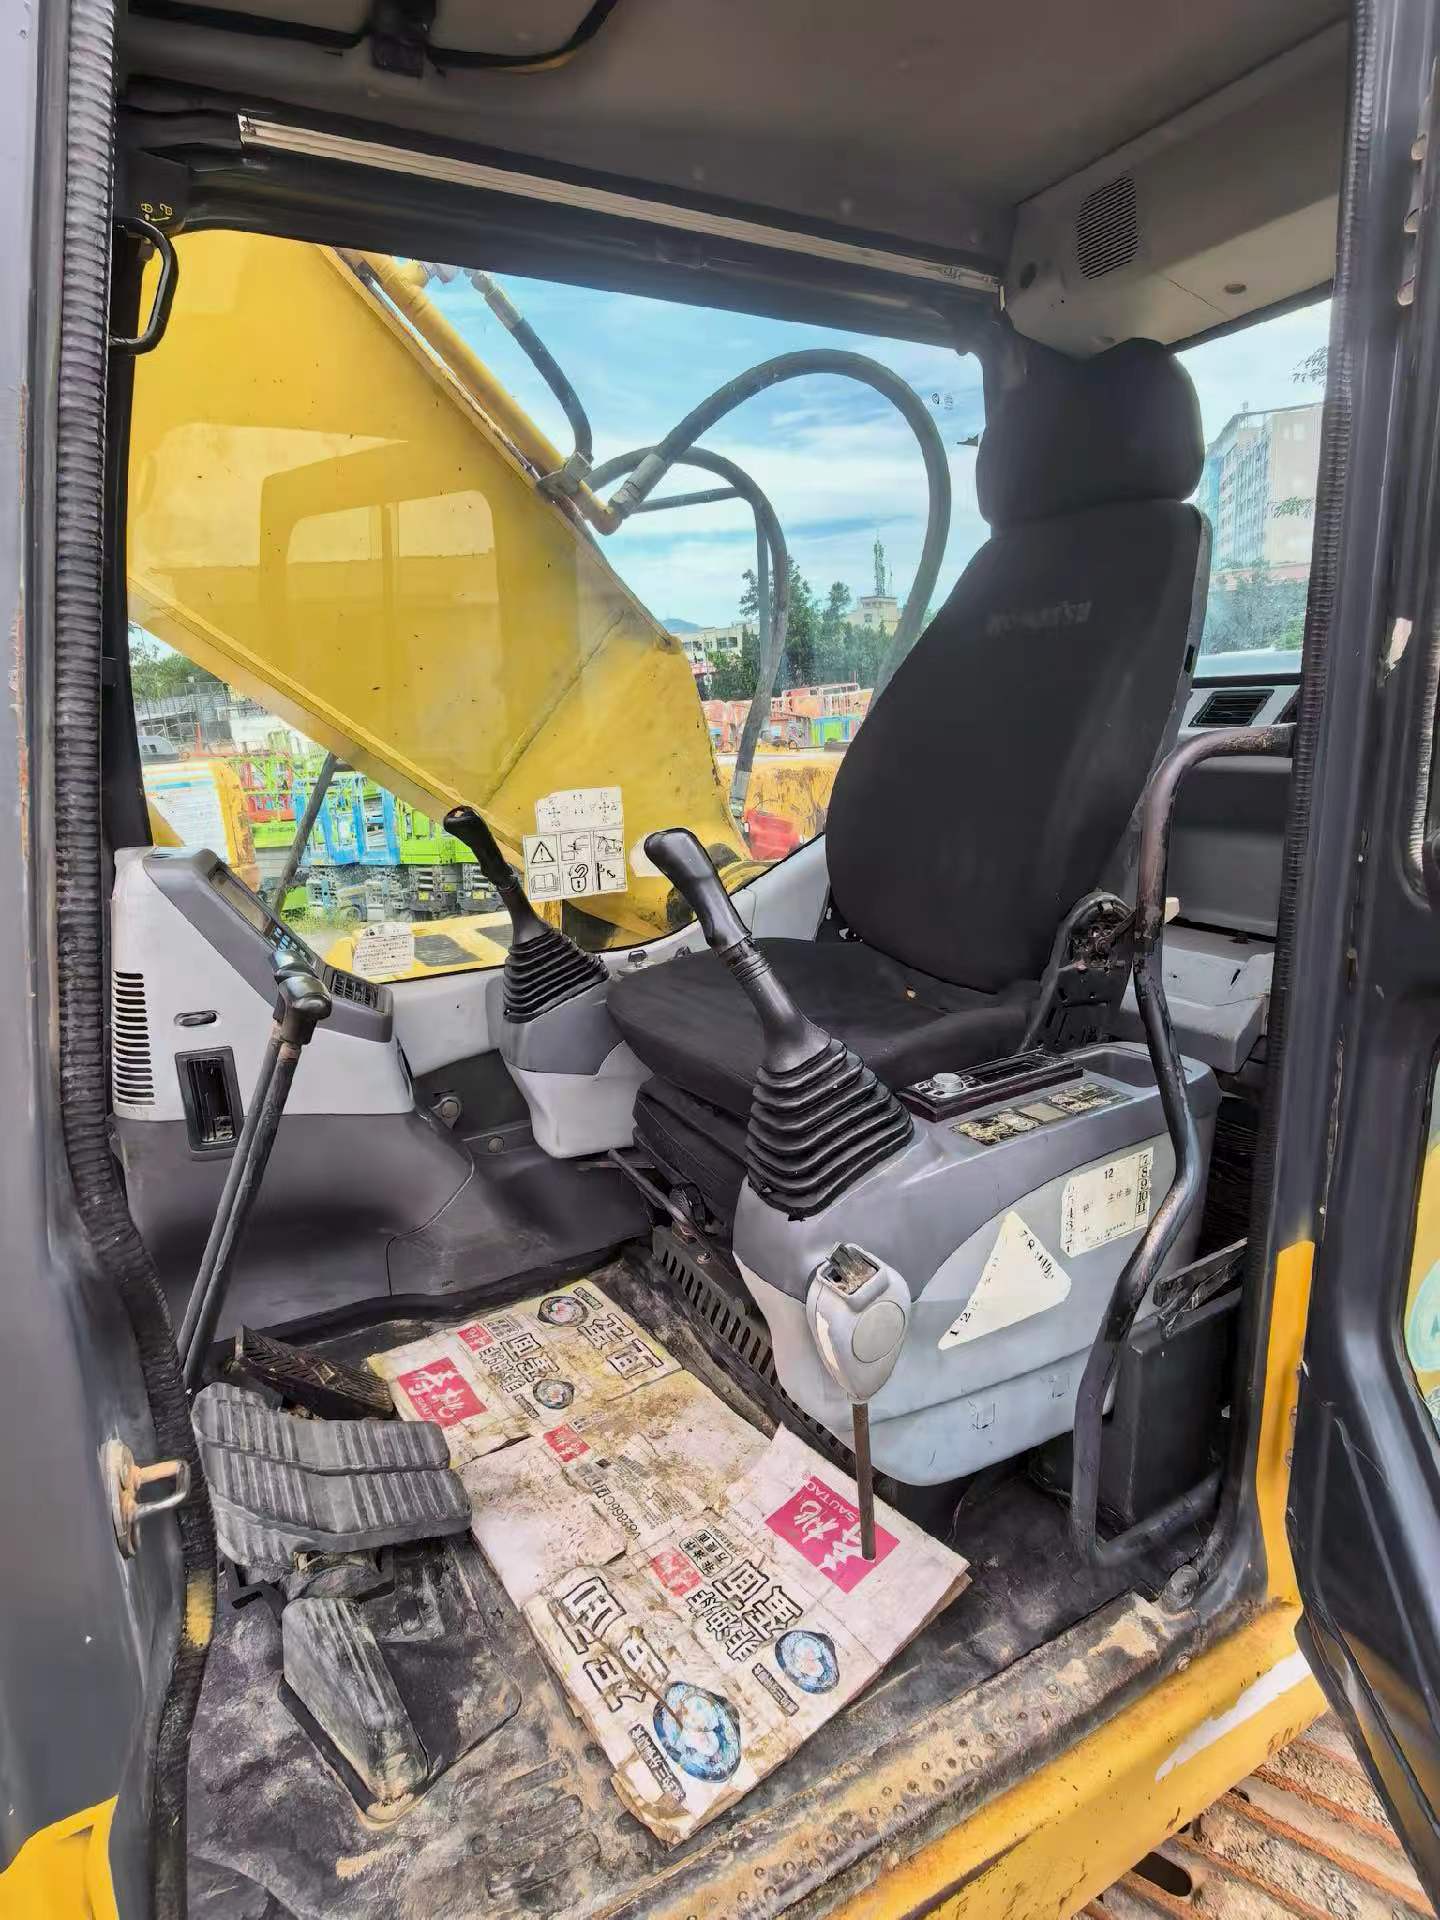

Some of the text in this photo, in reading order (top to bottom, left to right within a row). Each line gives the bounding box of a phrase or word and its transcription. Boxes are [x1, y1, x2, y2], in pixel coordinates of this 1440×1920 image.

[1104, 1168, 1114, 1179] 12
[1138, 1191, 1148, 1202] 10
[500, 1332, 560, 1382] 蛋面
[577, 1313, 664, 1380] 蛋面
[686, 1589, 762, 1663] 非油炸
[712, 1559, 803, 1641] 蛋面
[547, 1576, 671, 1713] 蛋面
